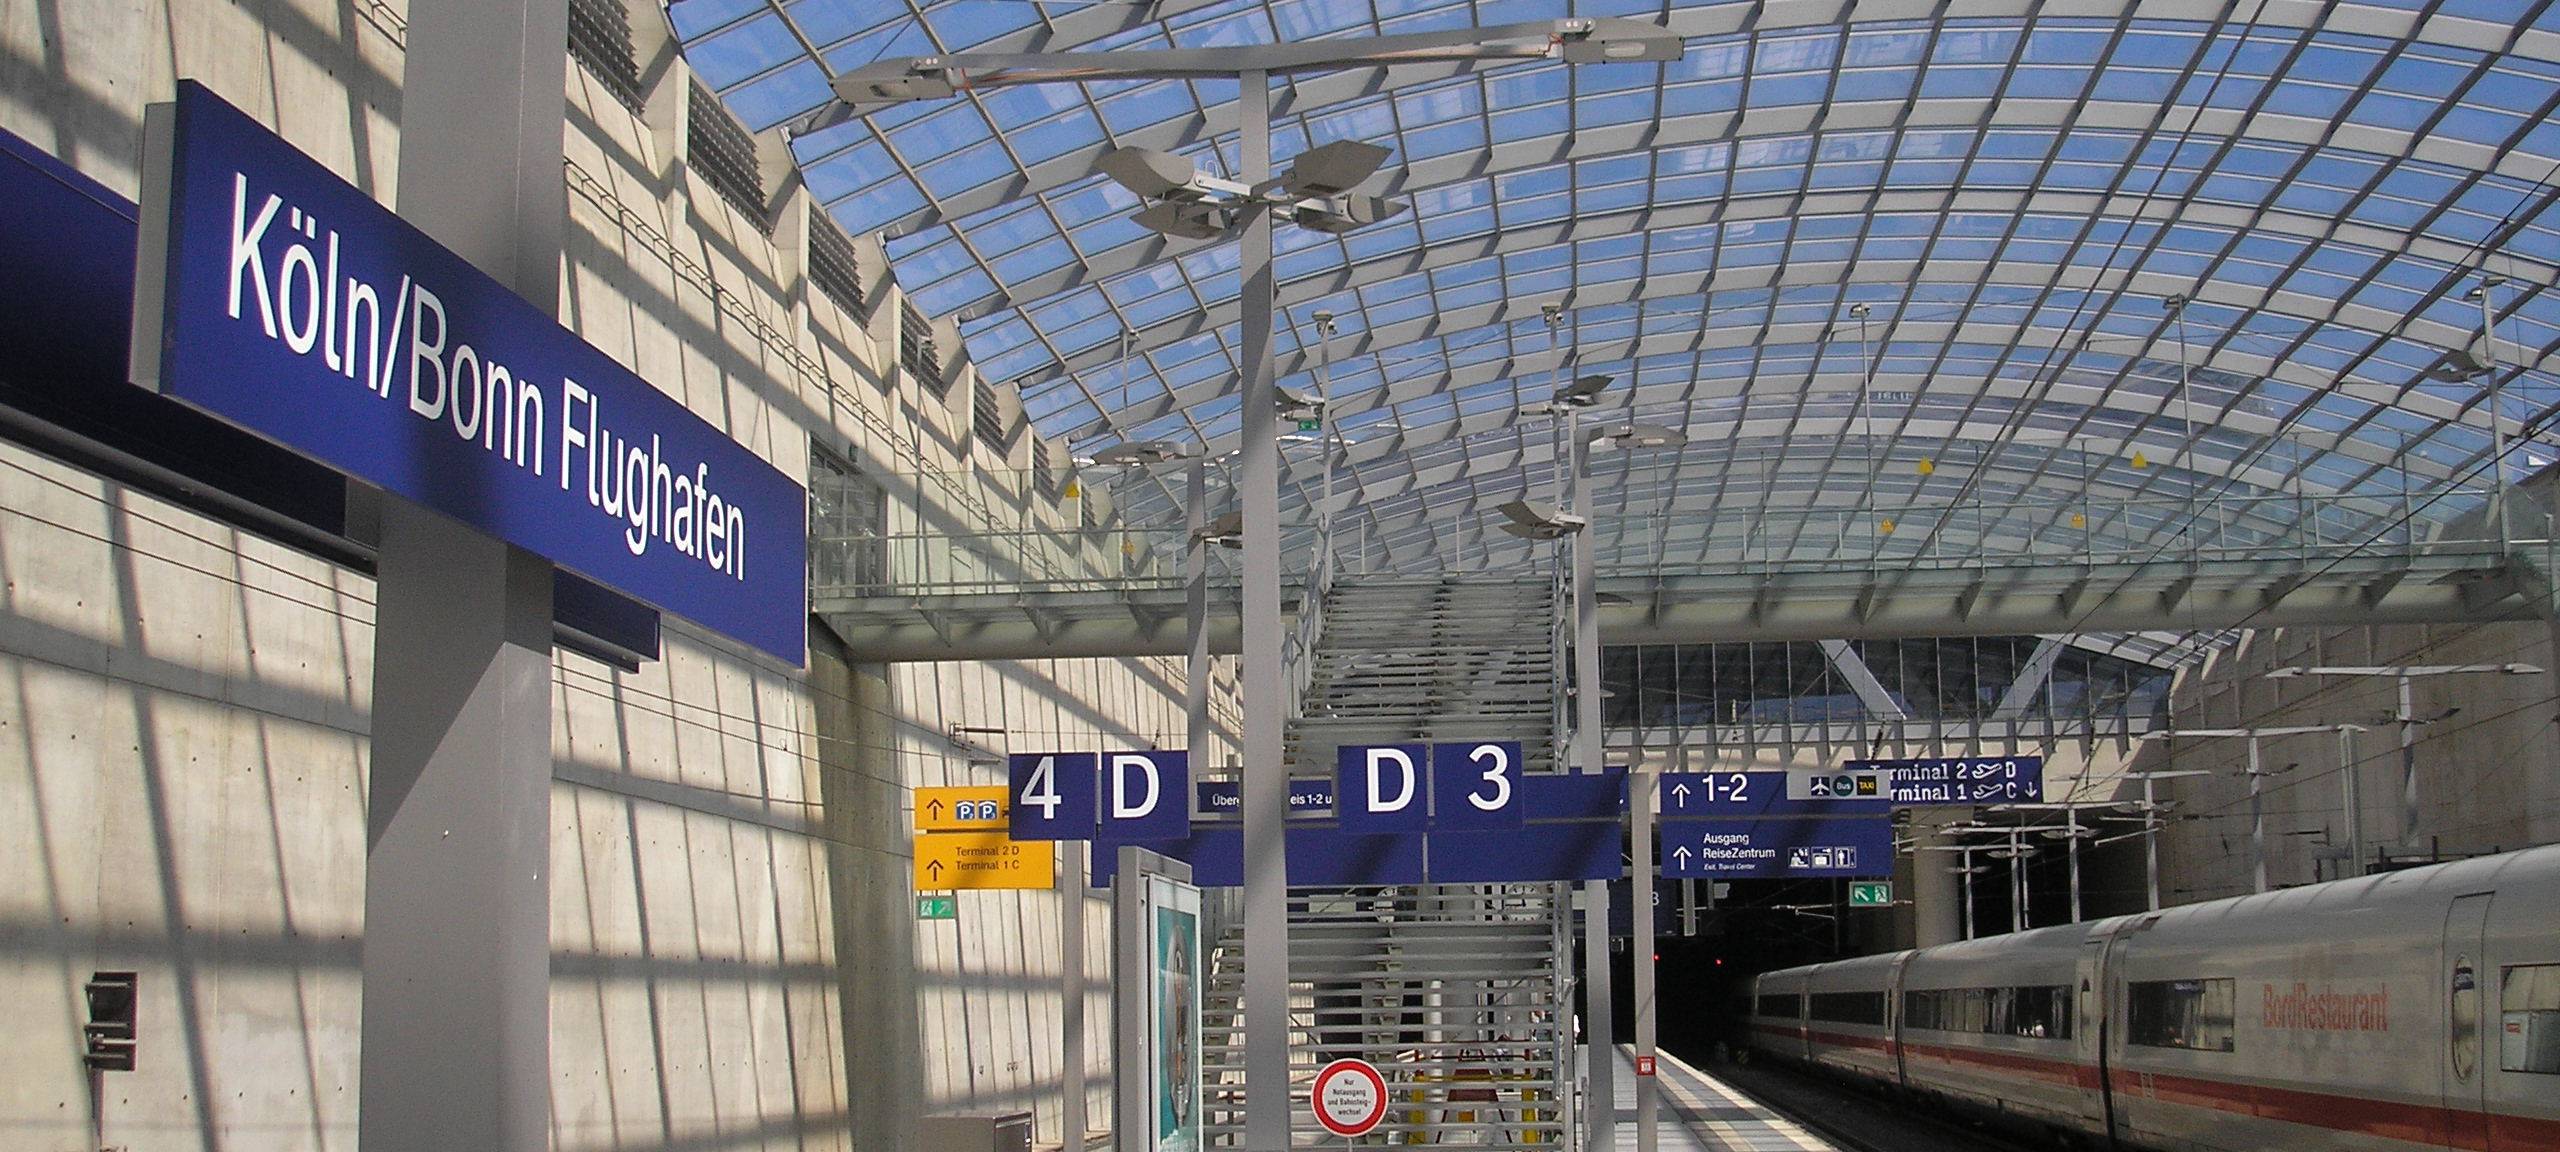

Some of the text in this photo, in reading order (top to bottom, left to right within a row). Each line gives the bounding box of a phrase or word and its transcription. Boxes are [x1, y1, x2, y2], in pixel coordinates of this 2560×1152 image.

[228, 172, 744, 581] Köln/Bonn Flughafen
[1467, 744, 1511, 811] 3
[1870, 762, 2016, 781] rminal 2 D
[1020, 756, 1062, 819] 4
[1112, 755, 1160, 818] D
[1366, 748, 1415, 812] D
[1702, 773, 1748, 802] 1-2
[1836, 782, 1851, 790] Bus
[1859, 781, 1875, 790] TAXI
[1889, 782, 2016, 801] rminal 1 C
[1212, 793, 1240, 807] Über
[1290, 794, 1306, 805] eis
[1306, 793, 1324, 805] 1-2
[1703, 832, 1750, 846] Ausgang
[956, 846, 1020, 857] Terminal 2 D
[1703, 847, 1776, 859] ReiseZentrum
[956, 860, 1020, 871] Terminal 1 C
[2263, 982, 2388, 1031] BordRestaurant
[1332, 1089, 1366, 1097] Notausgang
[1328, 1098, 1338, 1106] und
